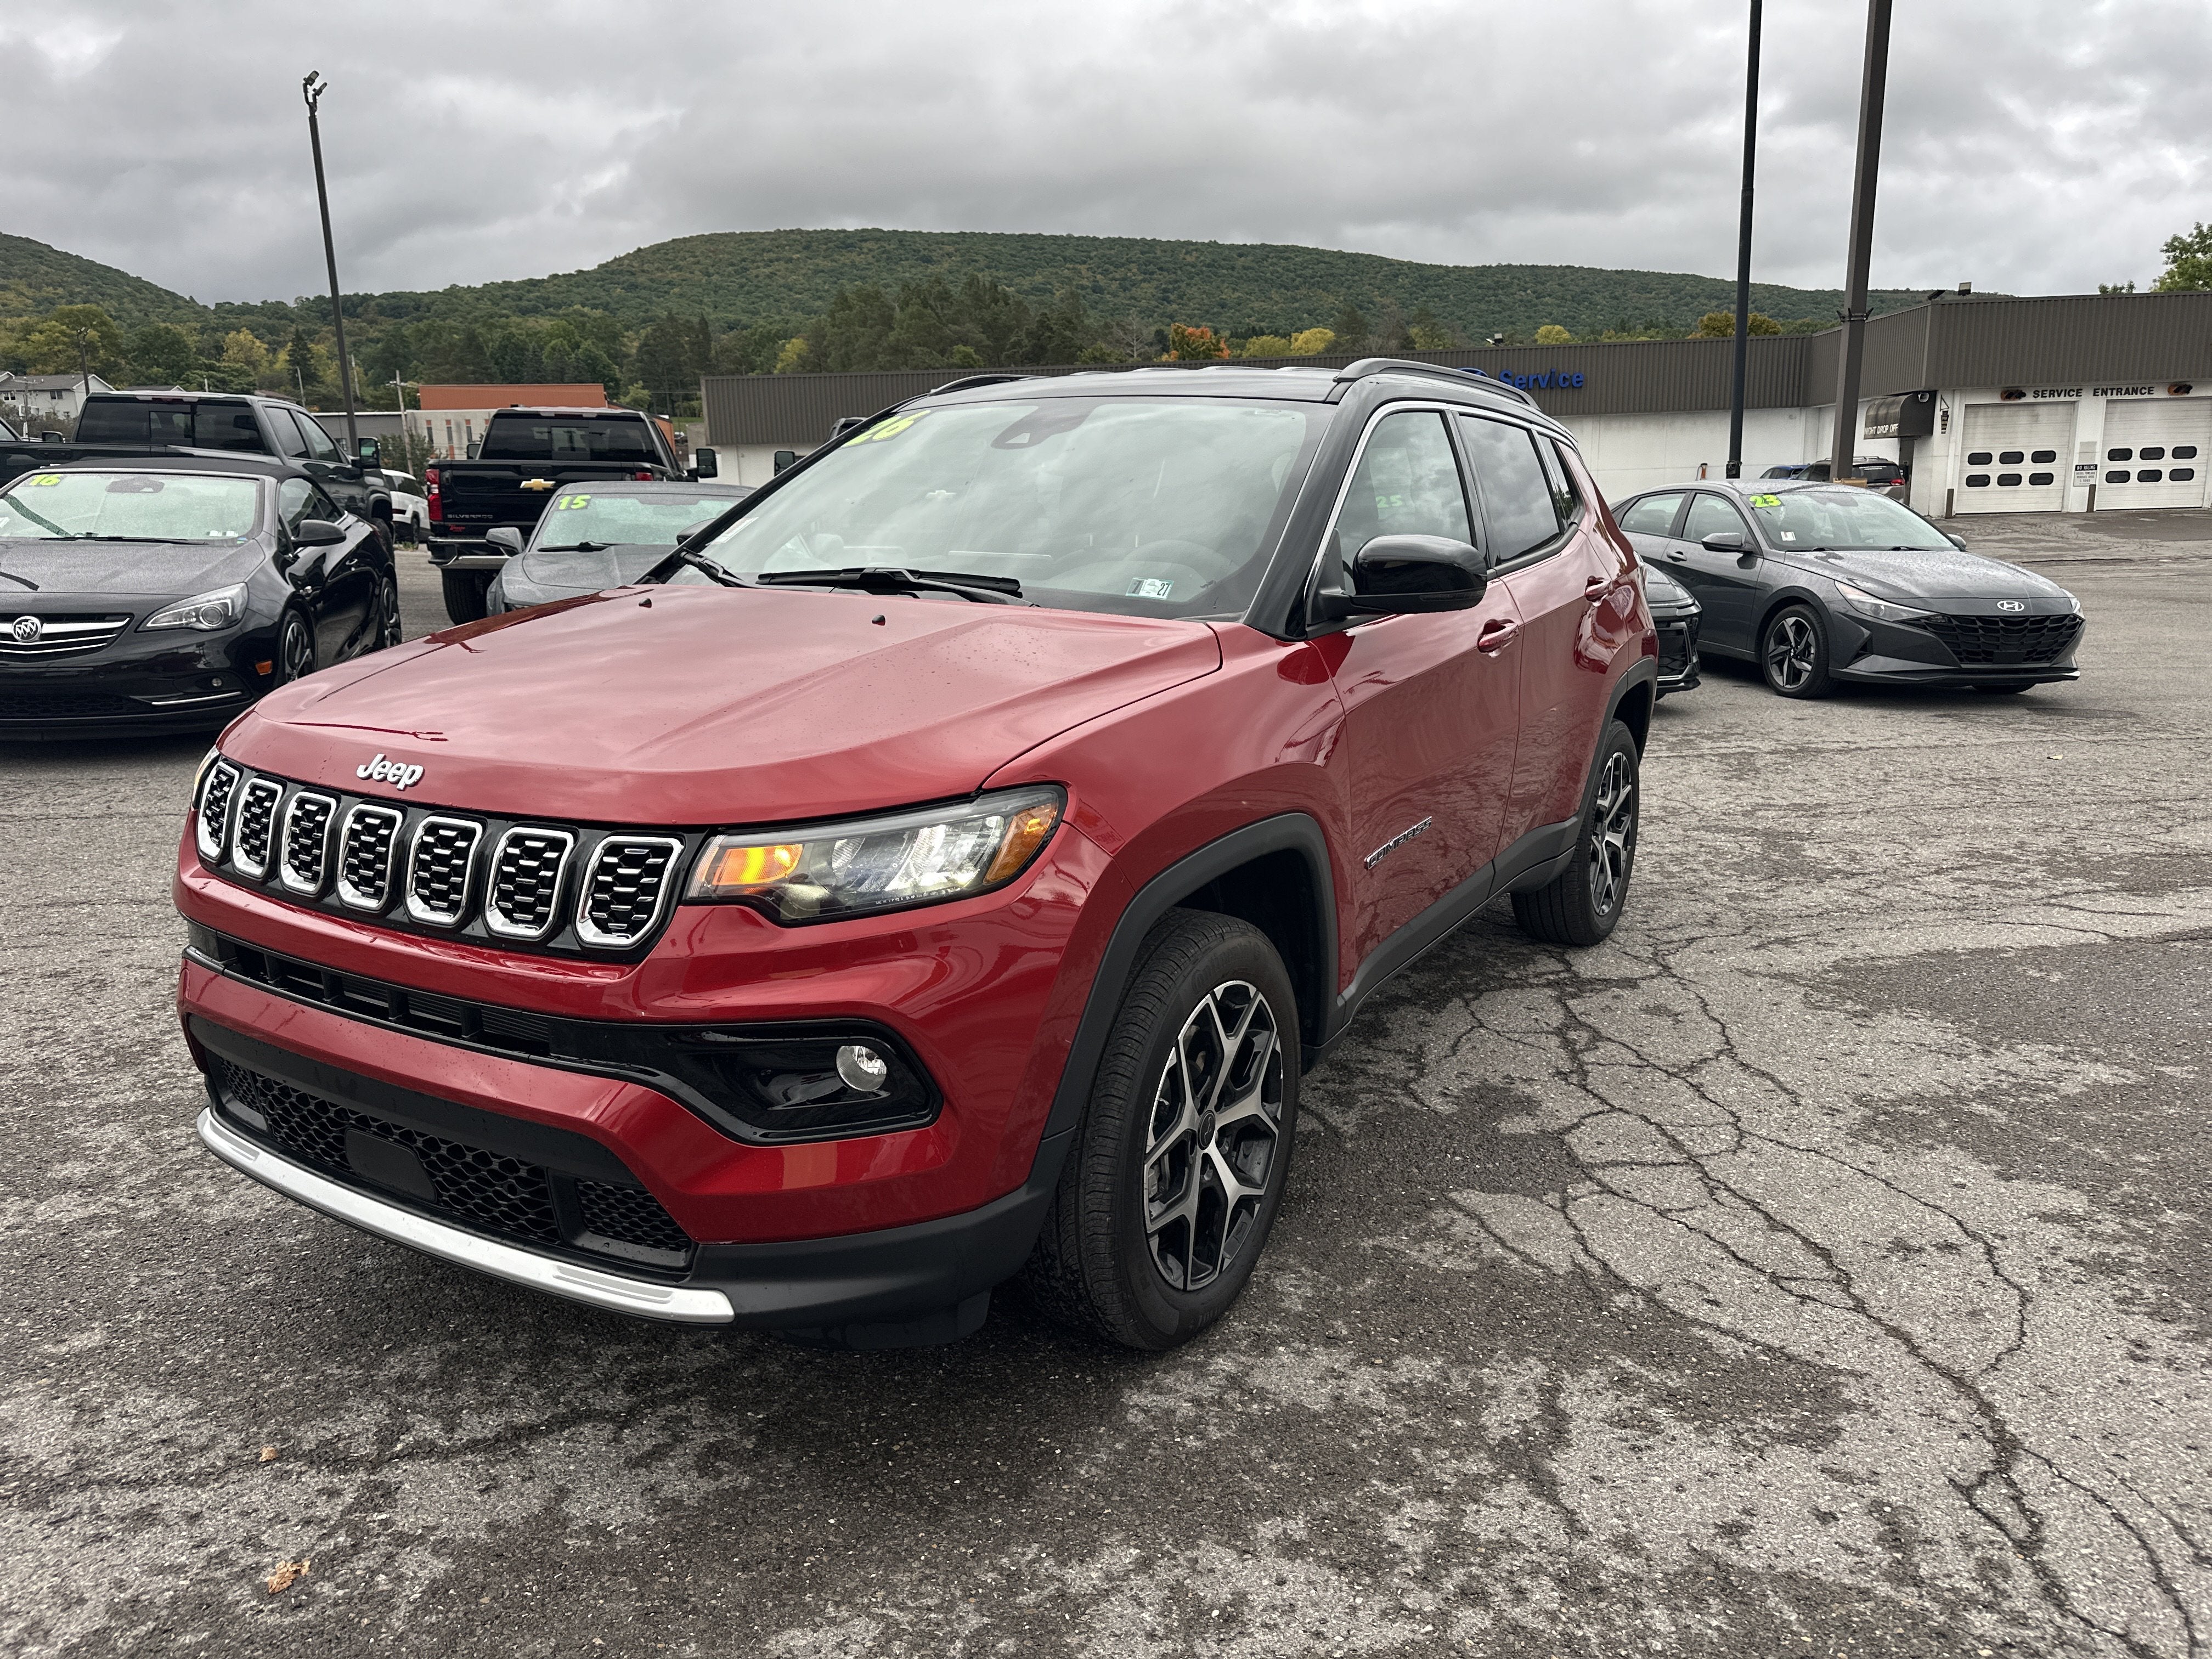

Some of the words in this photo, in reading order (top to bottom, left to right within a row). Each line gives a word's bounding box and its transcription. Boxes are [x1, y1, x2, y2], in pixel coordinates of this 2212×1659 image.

[1498, 368, 1585, 390] Service
[2033, 388, 2083, 398] SERVICE
[2092, 386, 2155, 397] ENTRANCE
[840, 410, 931, 448] 26
[1864, 426, 1877, 435] NIGHT
[1877, 425, 1889, 435] DROP
[1889, 423, 1899, 433] OFF
[29, 473, 63, 486] 16
[558, 495, 591, 510] 15
[1375, 495, 1403, 508] 25
[1749, 494, 1782, 507] 23
[1156, 582, 1171, 596] 27
[356, 753, 424, 791] Jeep
[1364, 816, 1432, 870] COMPASS
